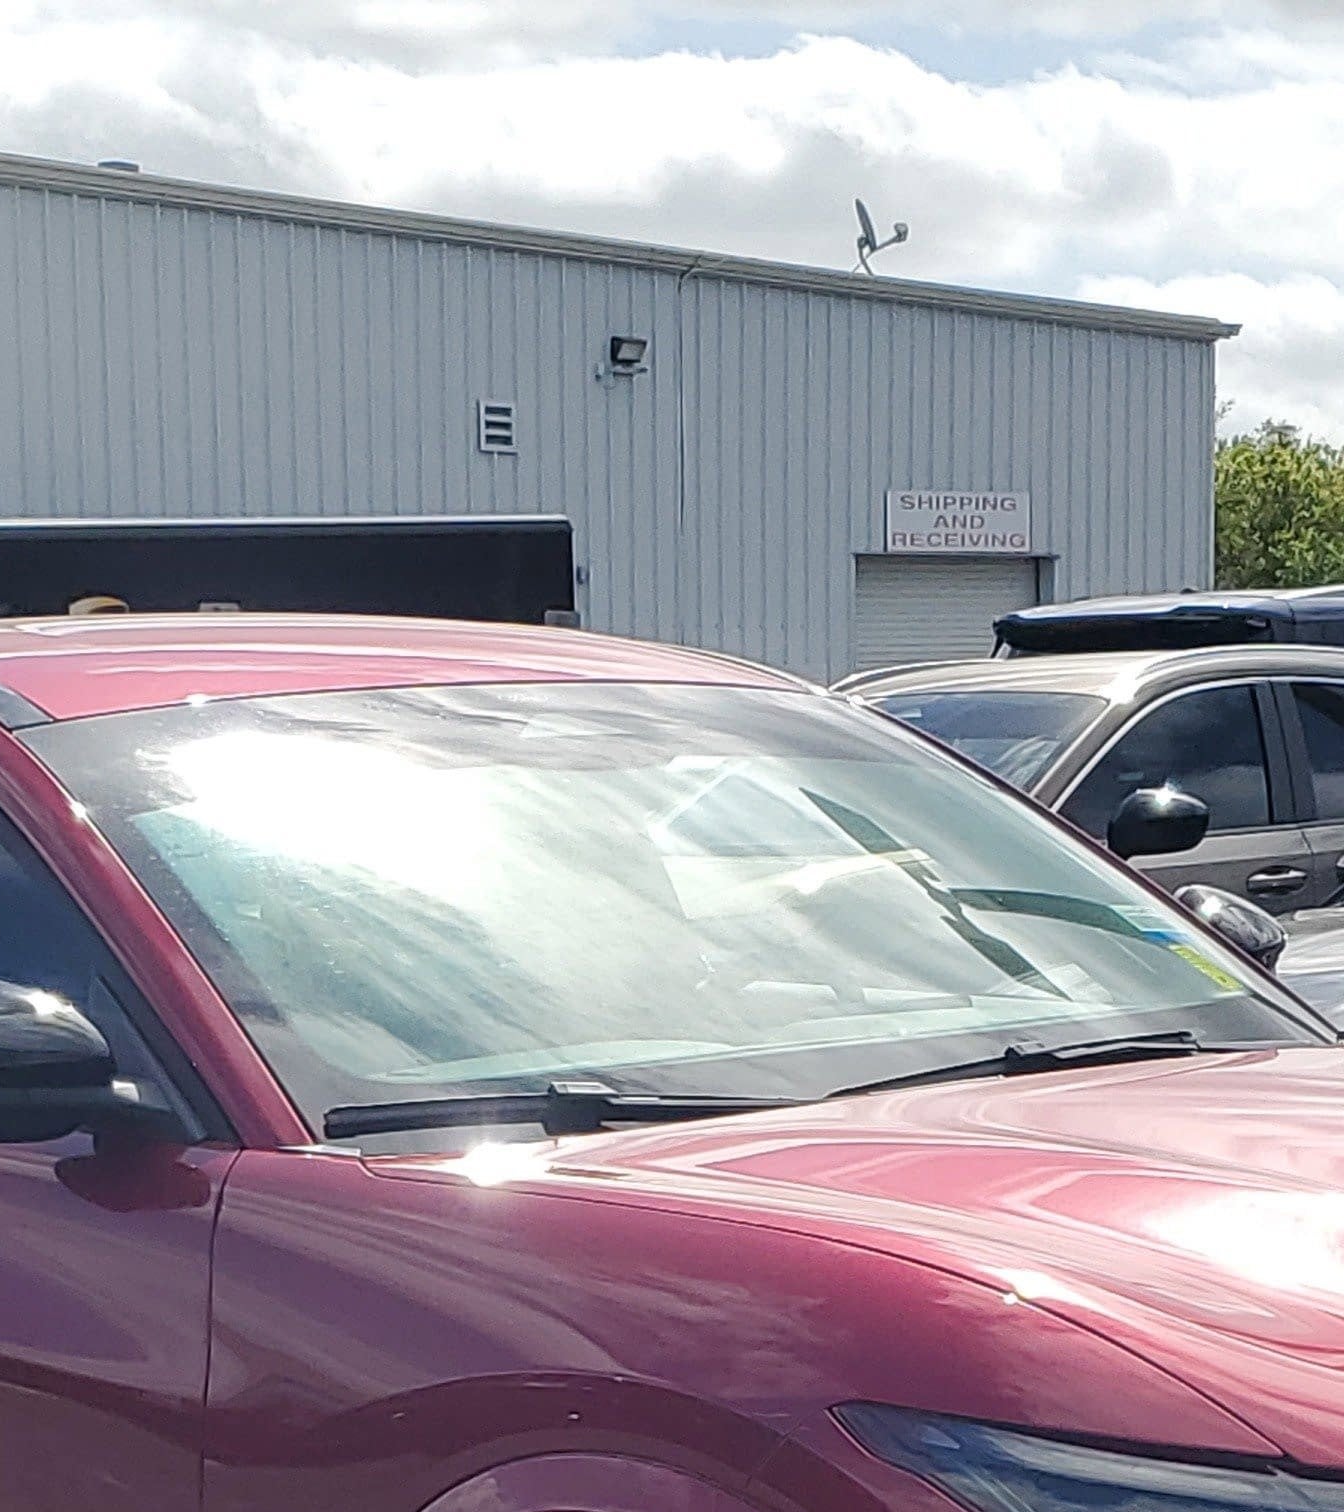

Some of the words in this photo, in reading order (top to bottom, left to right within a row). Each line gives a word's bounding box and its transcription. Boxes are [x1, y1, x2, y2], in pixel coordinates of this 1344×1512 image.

[900, 494, 1018, 512] SHIPPING
[933, 514, 986, 530] AND
[892, 532, 1026, 549] RECEIVING
